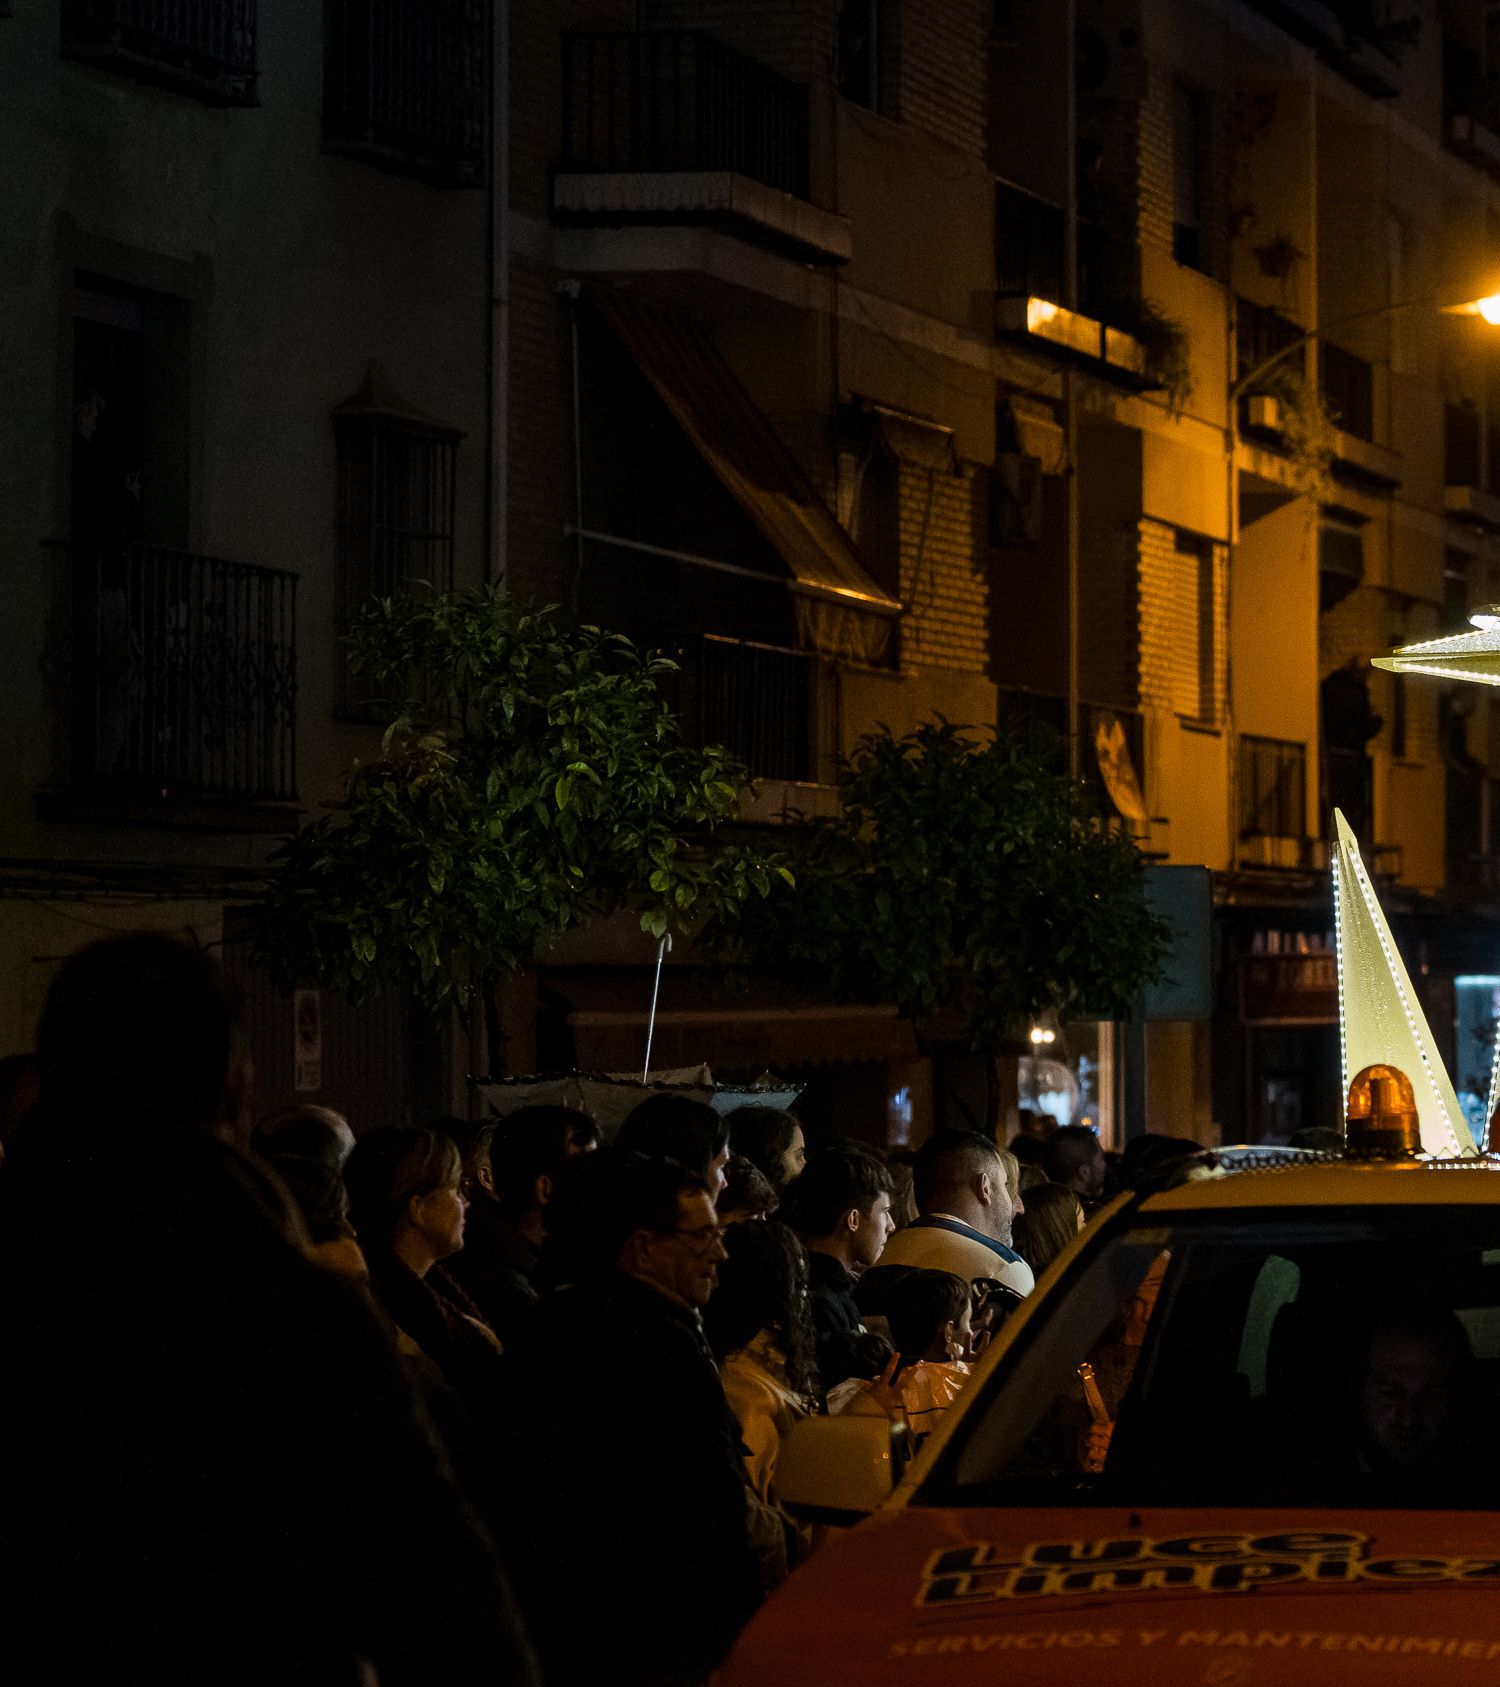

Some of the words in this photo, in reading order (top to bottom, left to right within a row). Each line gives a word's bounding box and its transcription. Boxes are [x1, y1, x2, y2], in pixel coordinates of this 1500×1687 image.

[921, 1530, 1370, 1578] Luce
[888, 1630, 1124, 1656] SERVICIOS
[1139, 1629, 1168, 1647] Y
